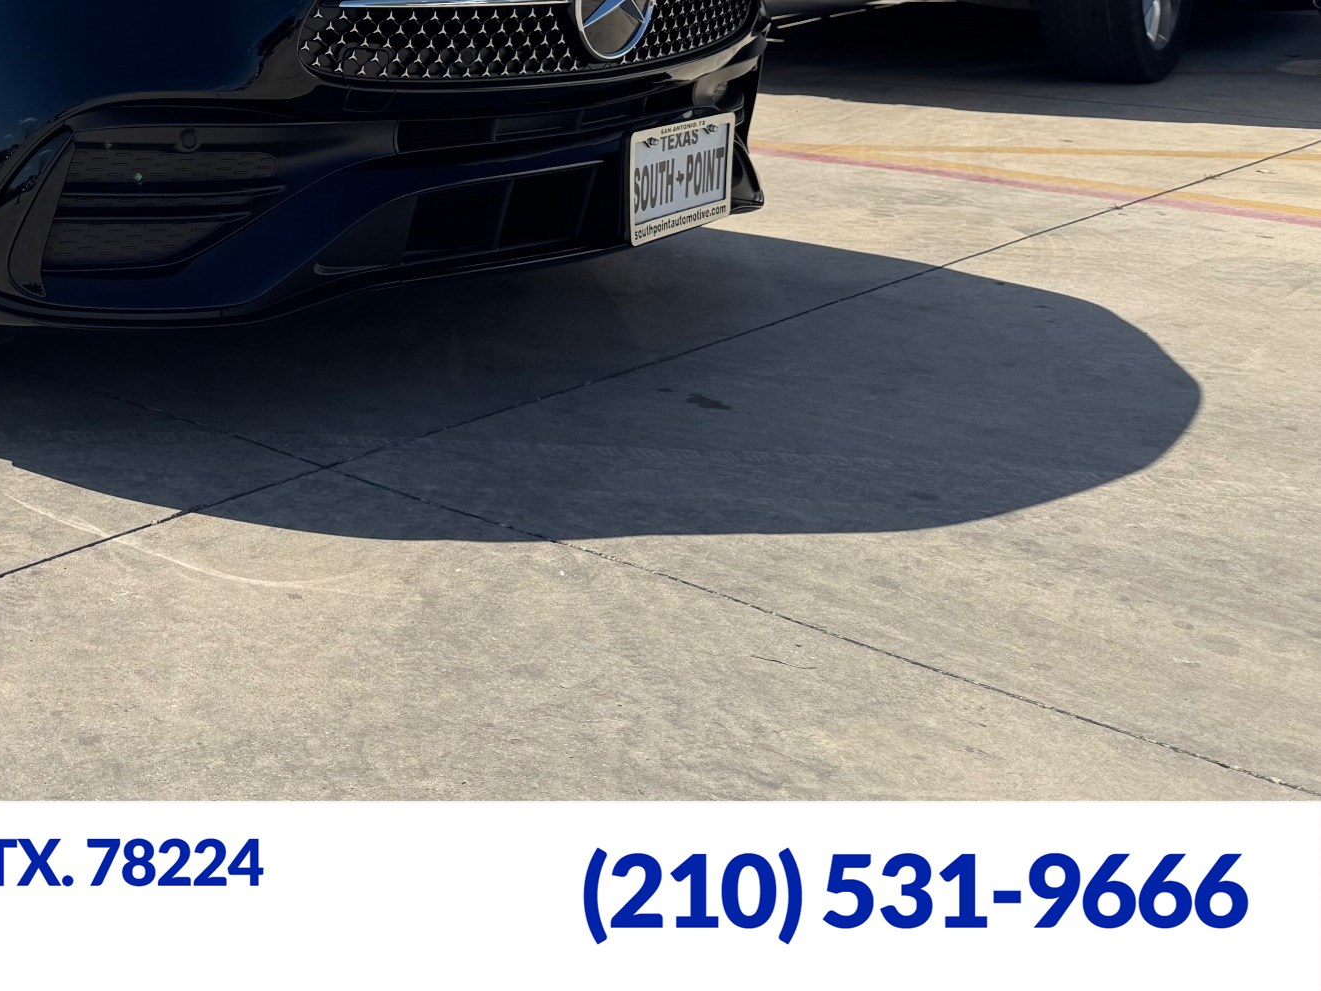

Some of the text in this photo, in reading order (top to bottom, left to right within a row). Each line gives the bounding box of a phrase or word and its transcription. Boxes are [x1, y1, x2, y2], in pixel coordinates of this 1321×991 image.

[660, 129, 699, 152] TEXAS
[634, 146, 725, 215] SOUTH POINT
[634, 204, 727, 241] southpointautomotive.com
